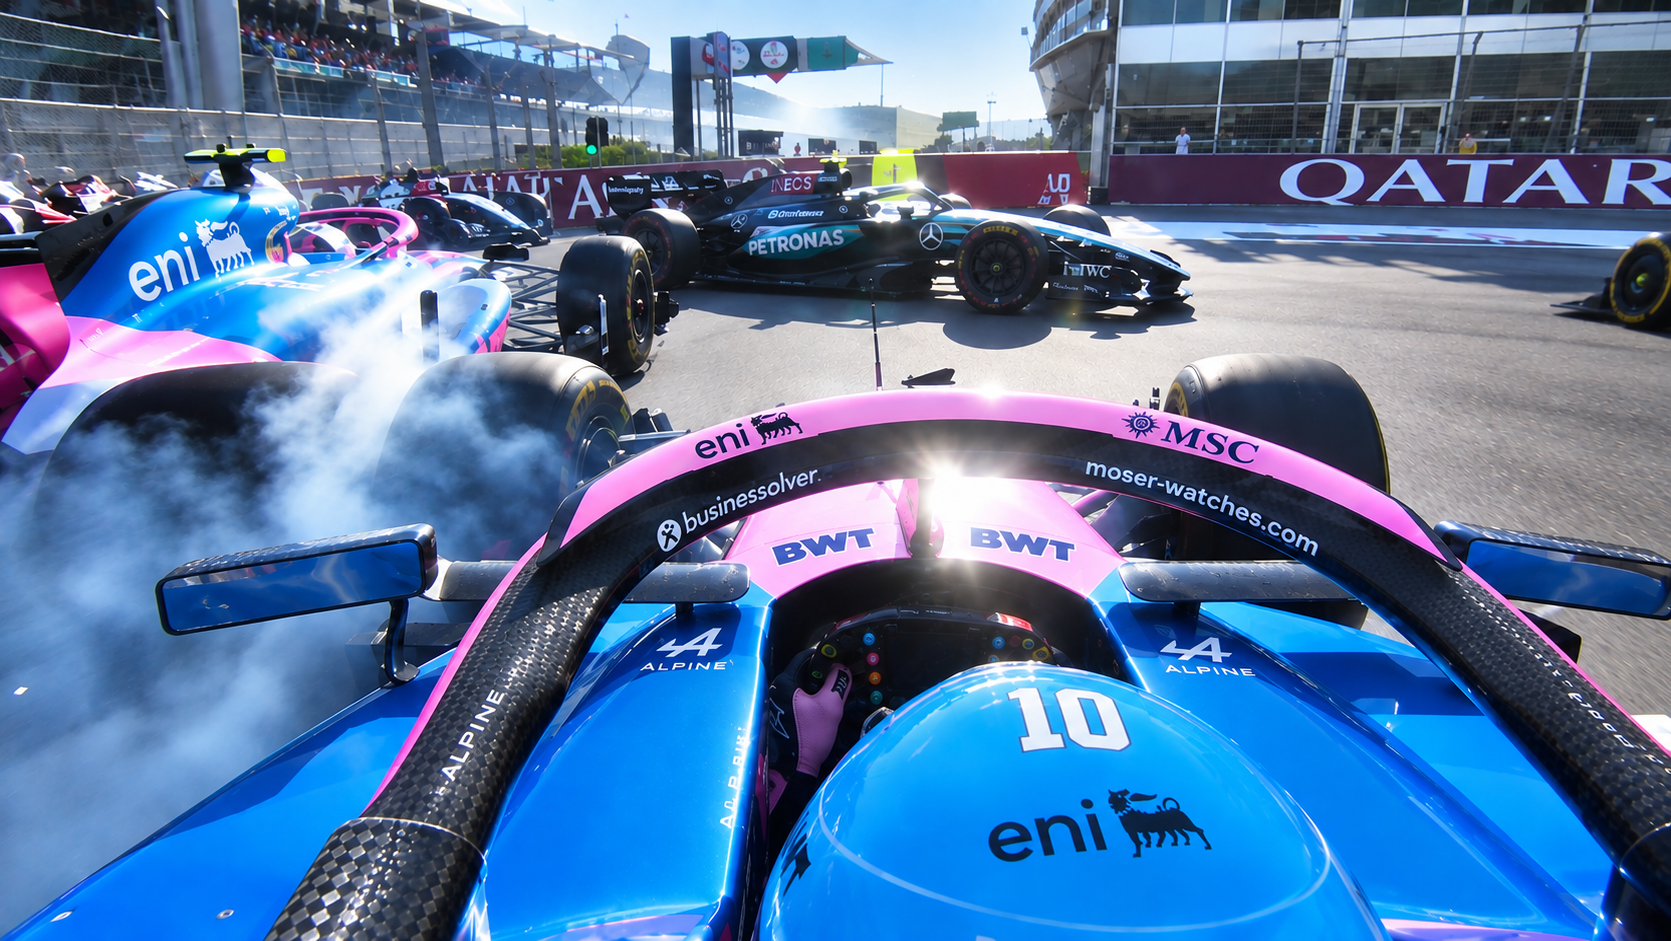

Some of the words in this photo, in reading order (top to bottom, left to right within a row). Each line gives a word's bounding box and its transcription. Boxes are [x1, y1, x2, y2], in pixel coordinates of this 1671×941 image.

[1279, 158, 1671, 206] QATAR
[748, 229, 845, 256] PETRONAS
[128, 231, 201, 302] eni
[695, 423, 750, 459] eni
[1160, 420, 1260, 464] MSC
[1085, 460, 1320, 557] moser-watches.com
[771, 527, 874, 566] BWT
[970, 526, 1075, 562] BWT
[640, 661, 728, 671] ALPINE
[1165, 664, 1256, 677] ALPINE
[441, 689, 505, 782] ALPINE
[1006, 687, 1132, 753] 10
[988, 798, 1108, 863] eni
